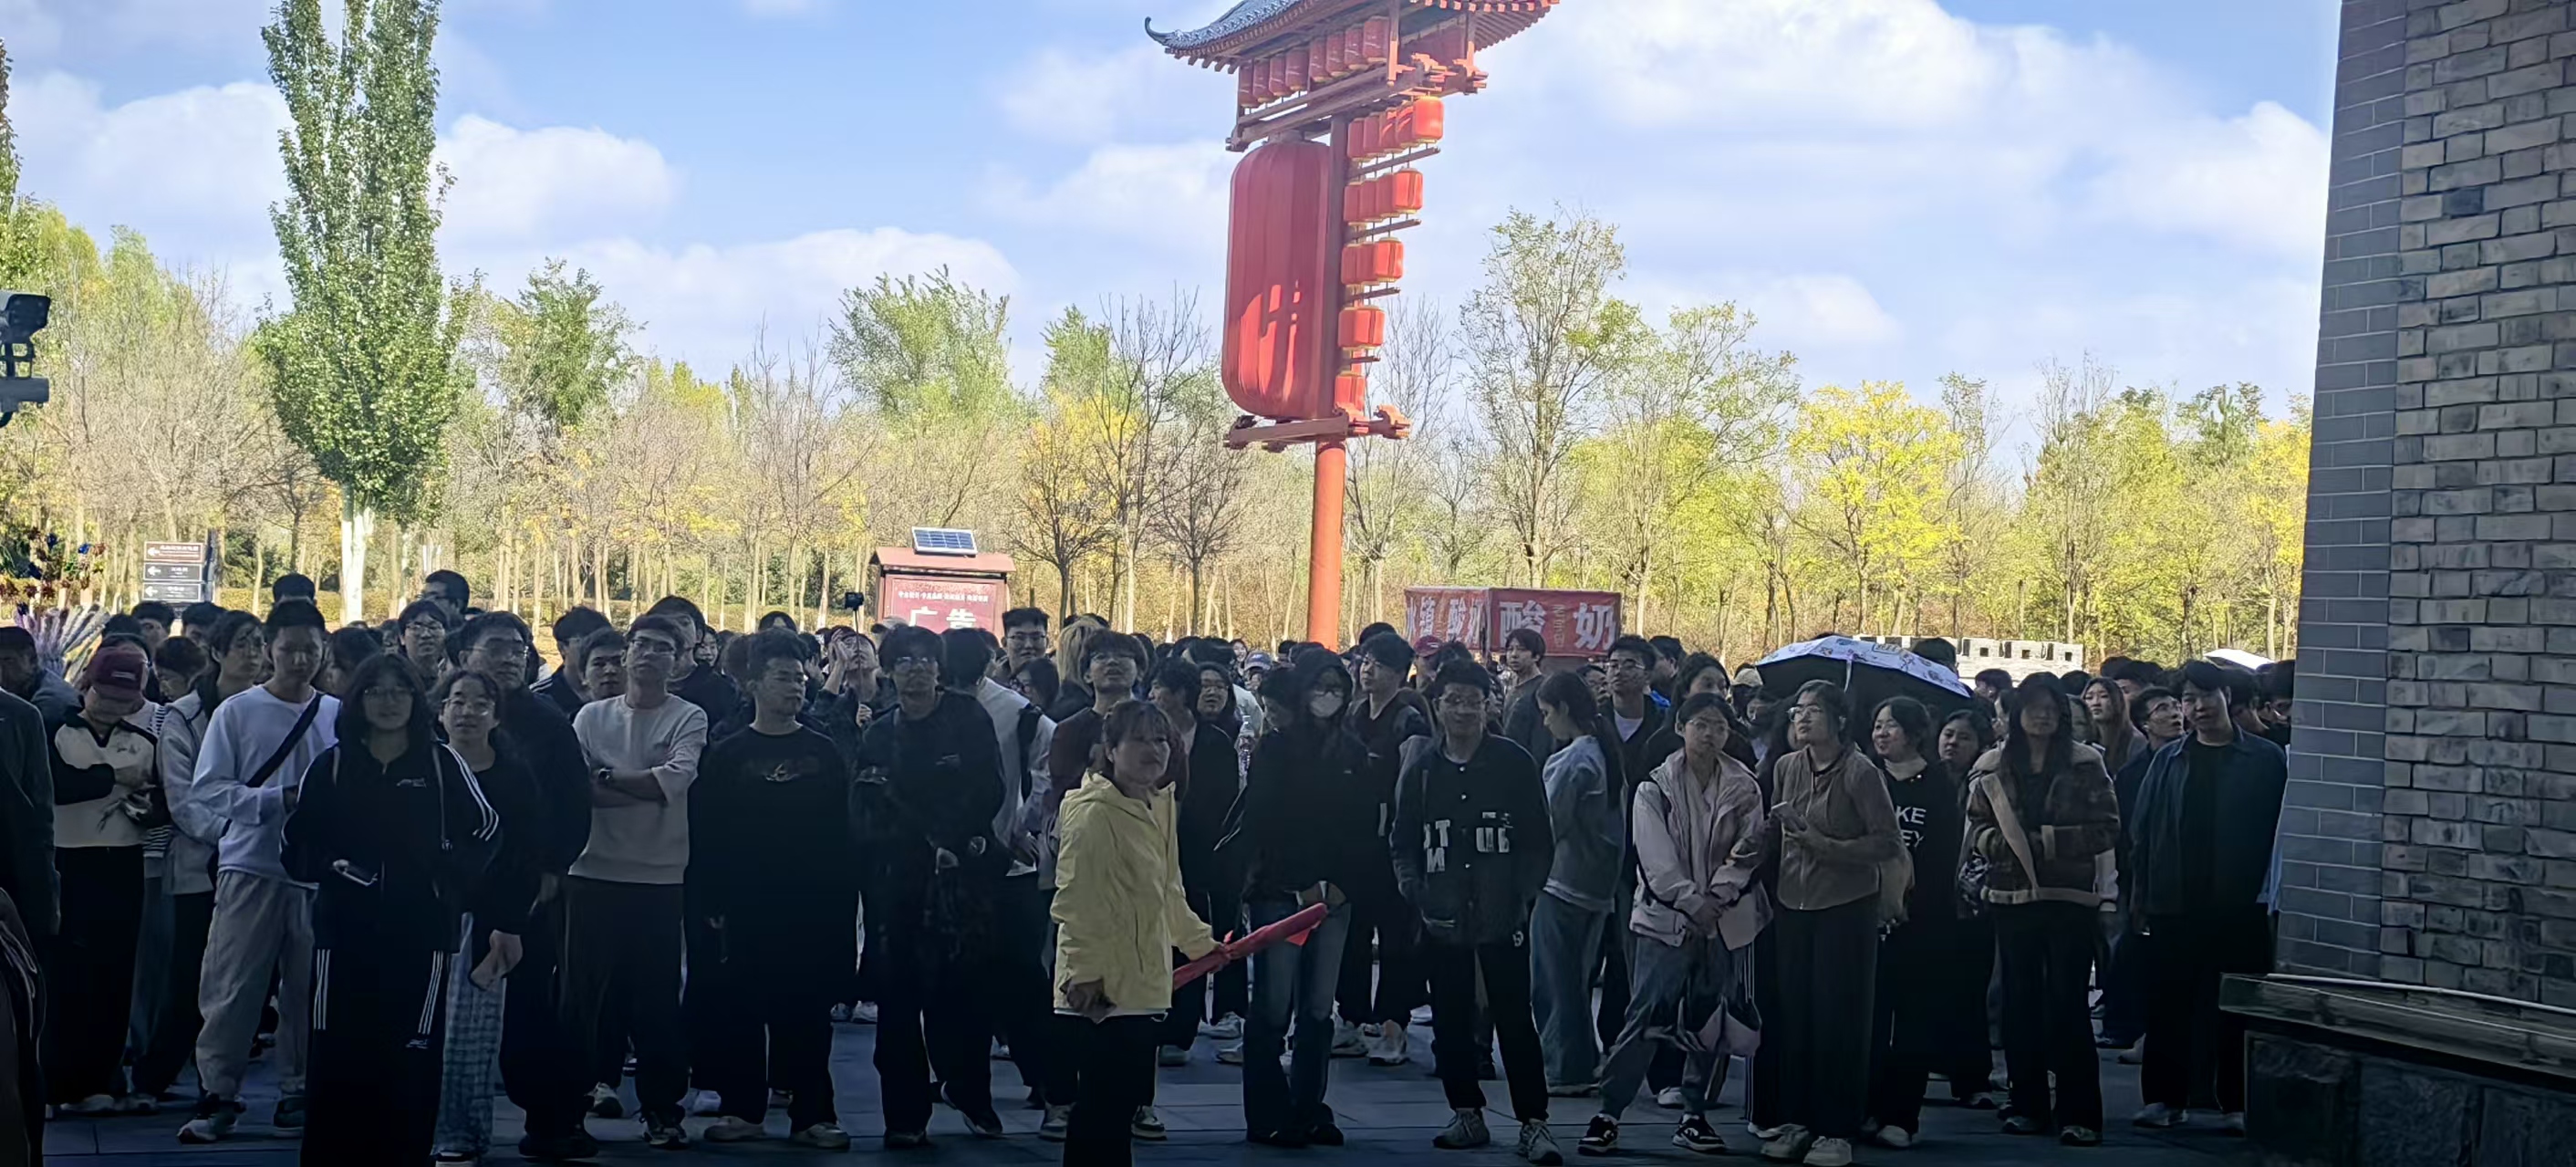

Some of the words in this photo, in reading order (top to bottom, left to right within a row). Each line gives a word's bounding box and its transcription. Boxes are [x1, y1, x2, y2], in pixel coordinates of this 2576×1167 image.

[909, 607, 976, 629] 广告
[1499, 599, 1616, 650] 酸奶
[1895, 805, 1927, 825] KE
[1899, 828, 1925, 848] EY
